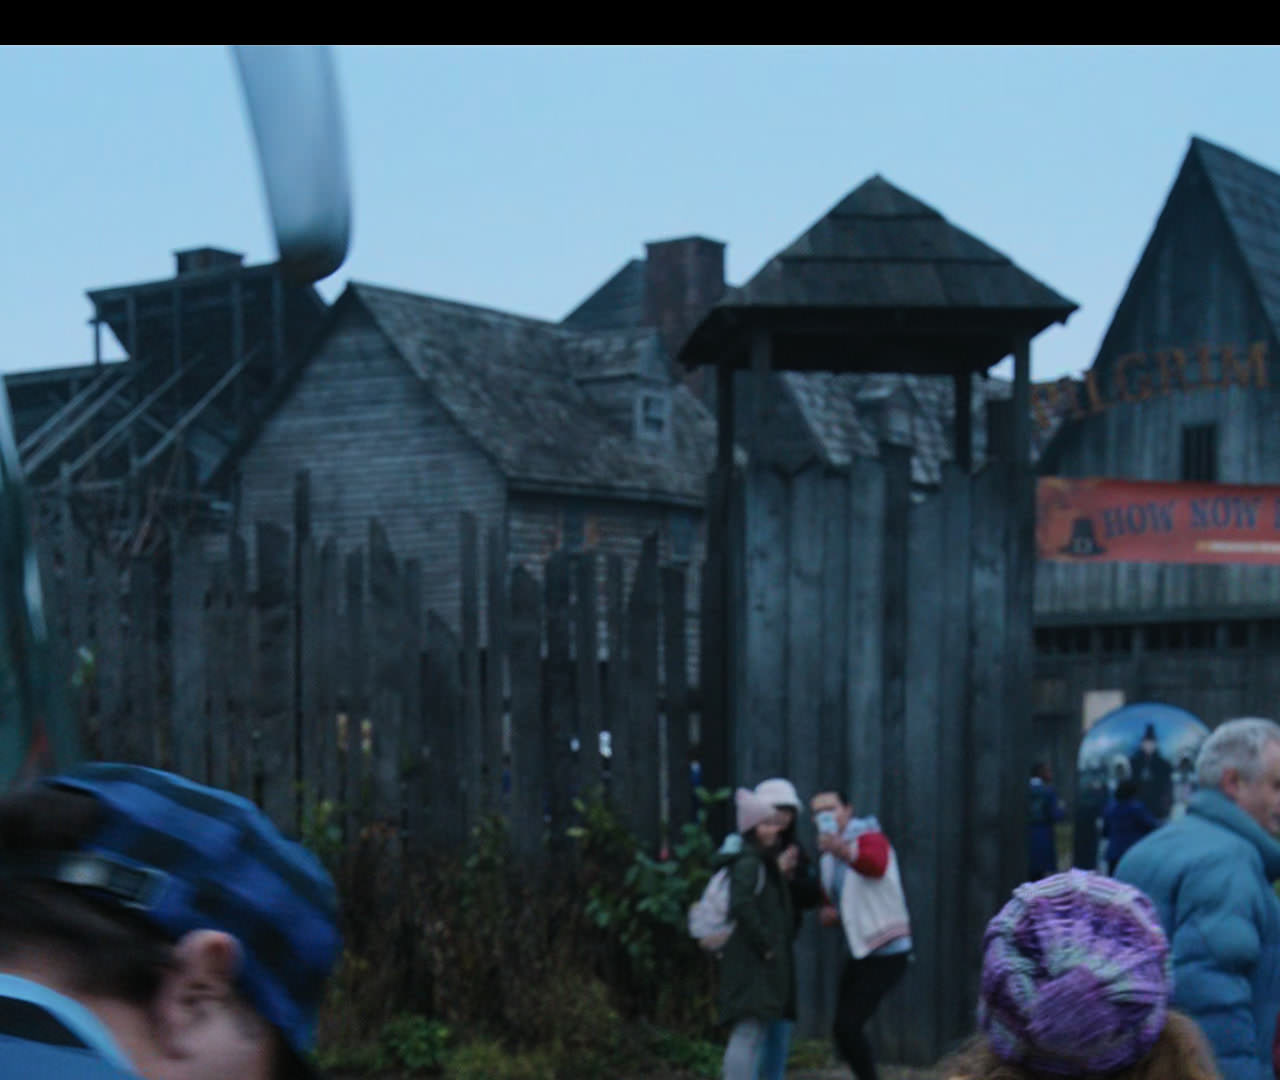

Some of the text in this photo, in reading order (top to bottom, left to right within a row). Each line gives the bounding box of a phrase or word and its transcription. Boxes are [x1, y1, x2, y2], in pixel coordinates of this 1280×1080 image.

[1029, 343, 1274, 430] PILGRIM
[1103, 501, 1175, 539] HOW
[1190, 496, 1263, 530] NOW
